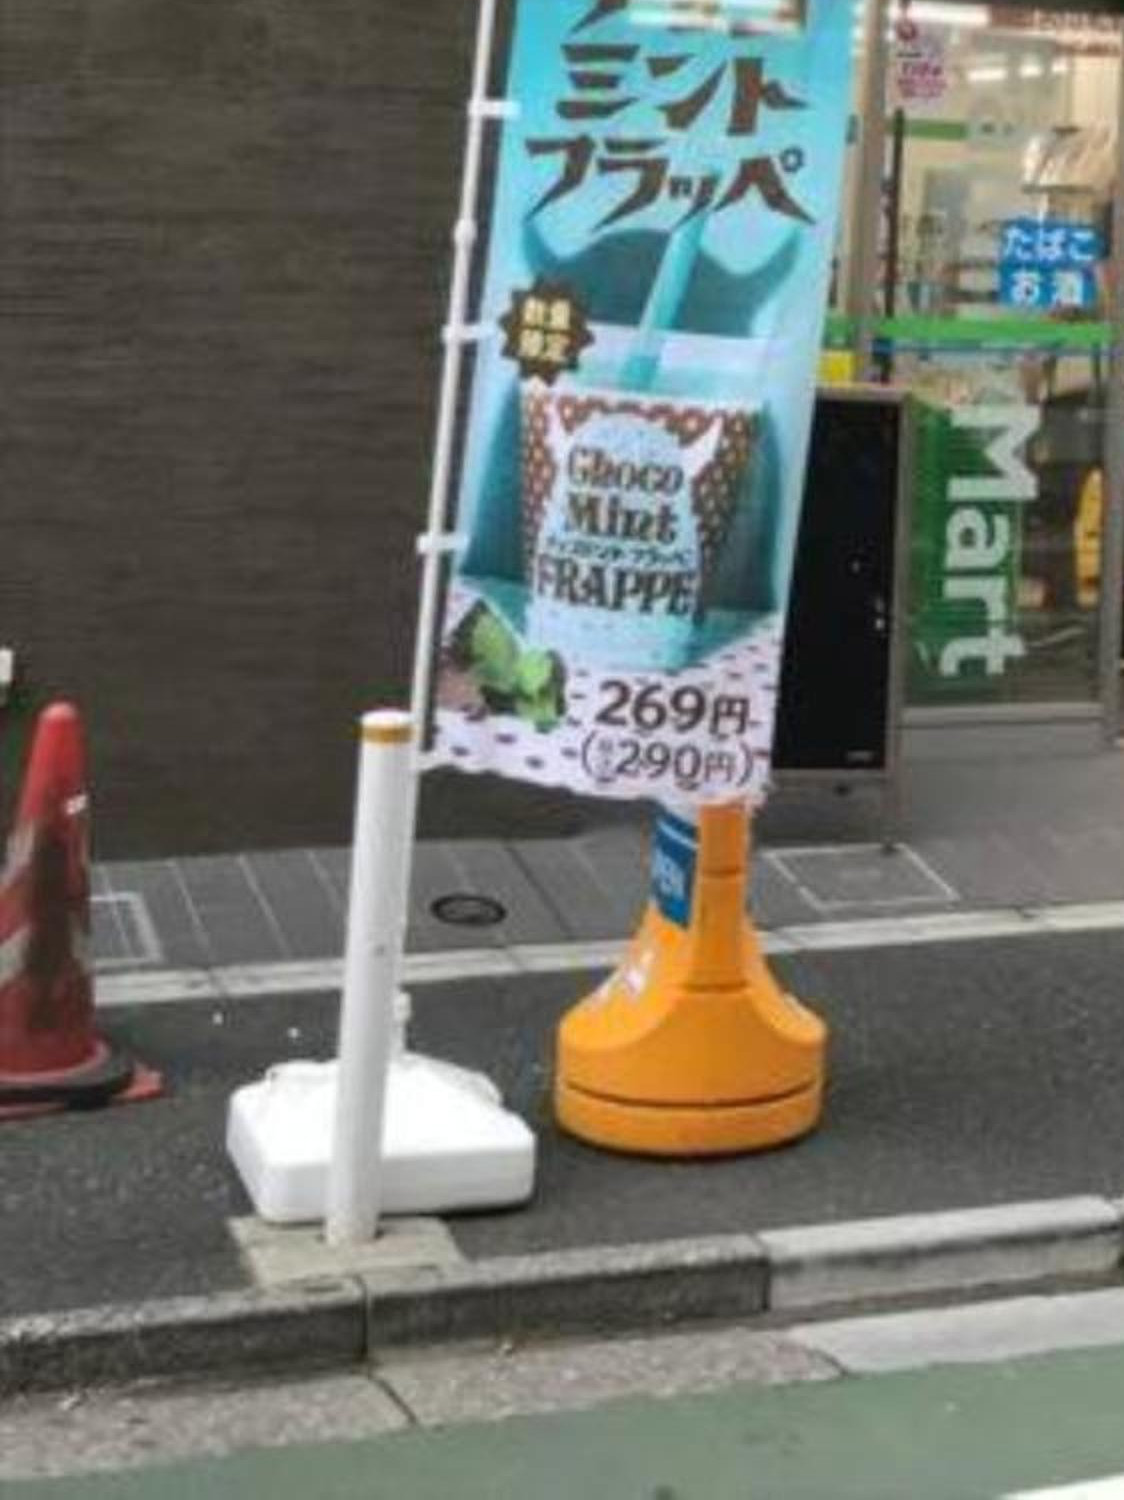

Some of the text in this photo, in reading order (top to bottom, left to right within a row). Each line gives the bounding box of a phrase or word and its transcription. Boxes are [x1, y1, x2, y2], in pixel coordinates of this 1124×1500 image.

[555, 44, 810, 137] ミント
[524, 133, 816, 233] フラッペ
[1004, 227, 1095, 262] たばこ
[566, 490, 678, 545] Mint
[595, 680, 749, 736] 269円
